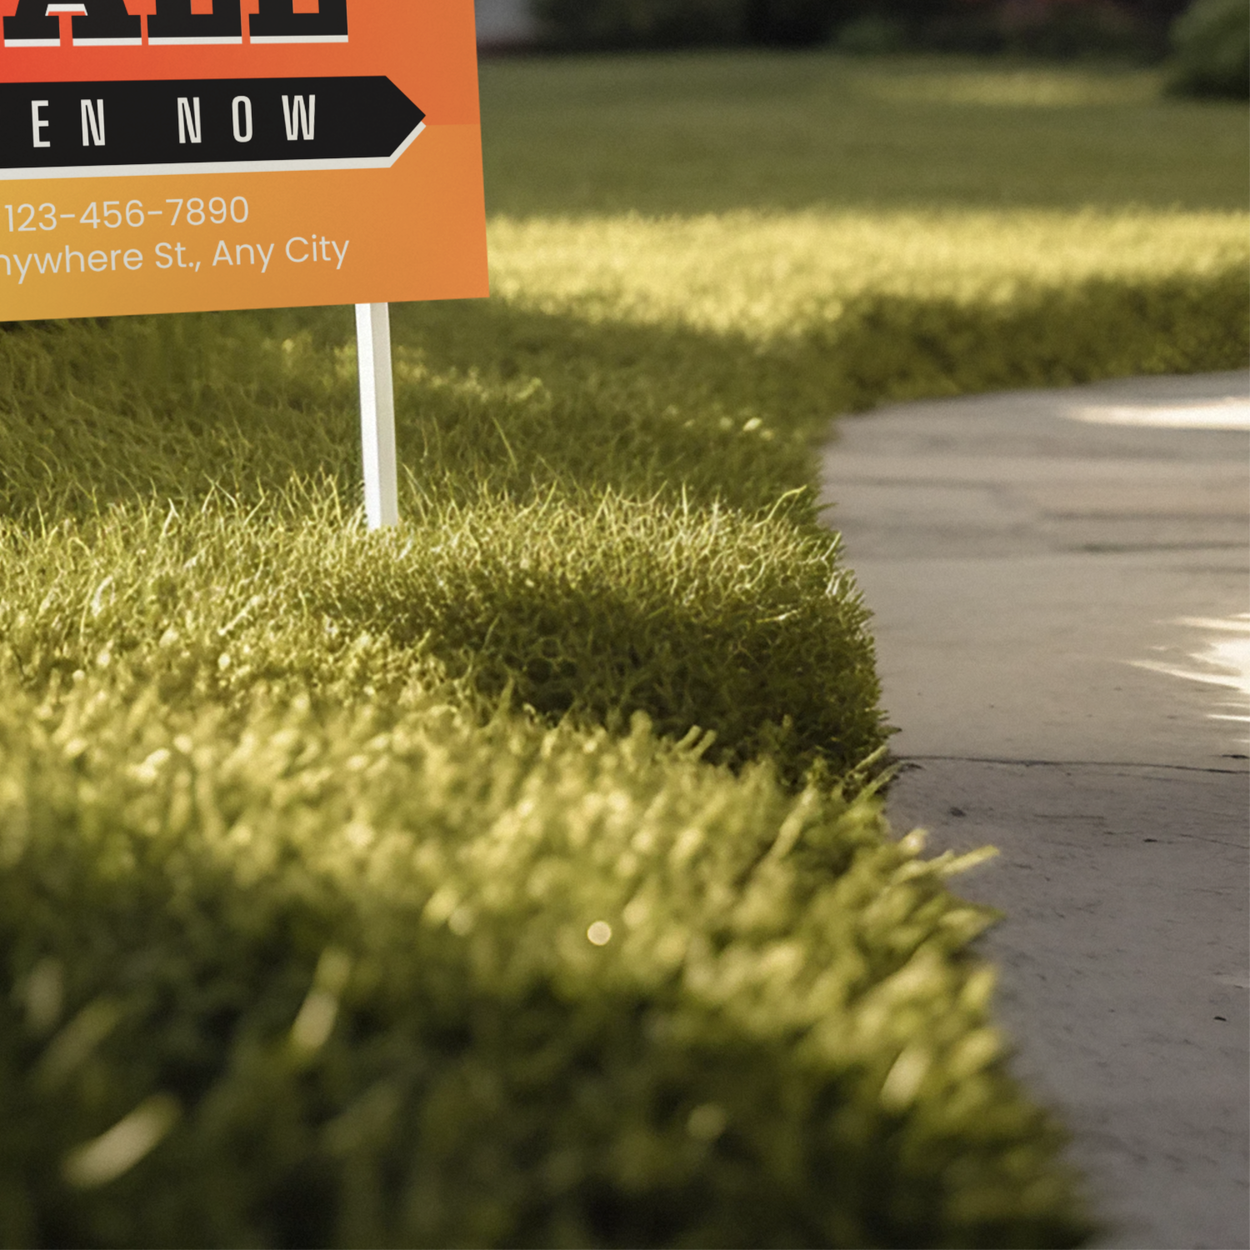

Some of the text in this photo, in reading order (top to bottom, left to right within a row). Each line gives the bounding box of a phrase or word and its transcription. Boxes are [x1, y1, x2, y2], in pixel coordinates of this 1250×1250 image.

[177, 94, 318, 144] NOW
[4, 195, 250, 233] 123-456-7890
[153, 240, 202, 272] St.,
[211, 237, 276, 273] Any
[284, 234, 350, 270] City
